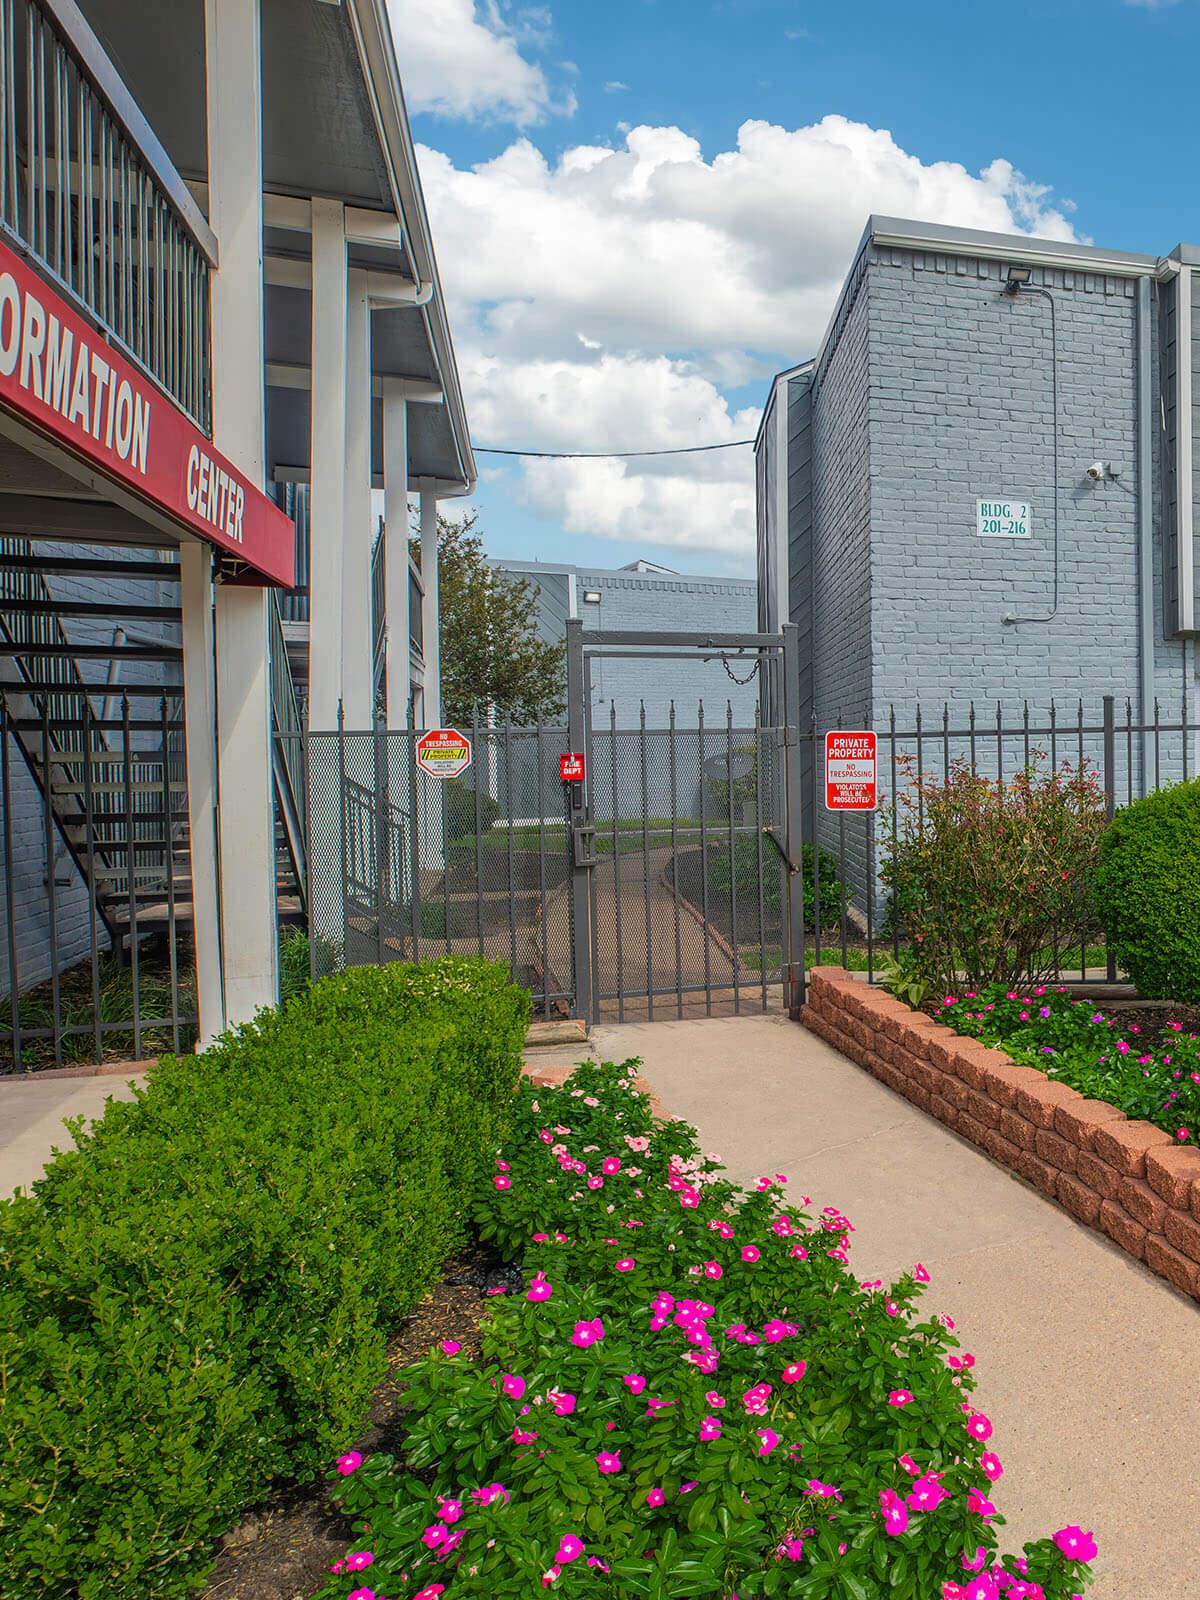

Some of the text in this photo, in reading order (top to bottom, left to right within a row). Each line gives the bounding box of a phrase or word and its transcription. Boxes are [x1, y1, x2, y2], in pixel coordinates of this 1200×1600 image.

[186, 443, 245, 544] CENTER
[981, 503, 1026, 518] BLDG. 2
[982, 520, 1026, 534] 201-216
[833, 738, 869, 748] PRIVATE
[829, 748, 874, 758] PROPERTY
